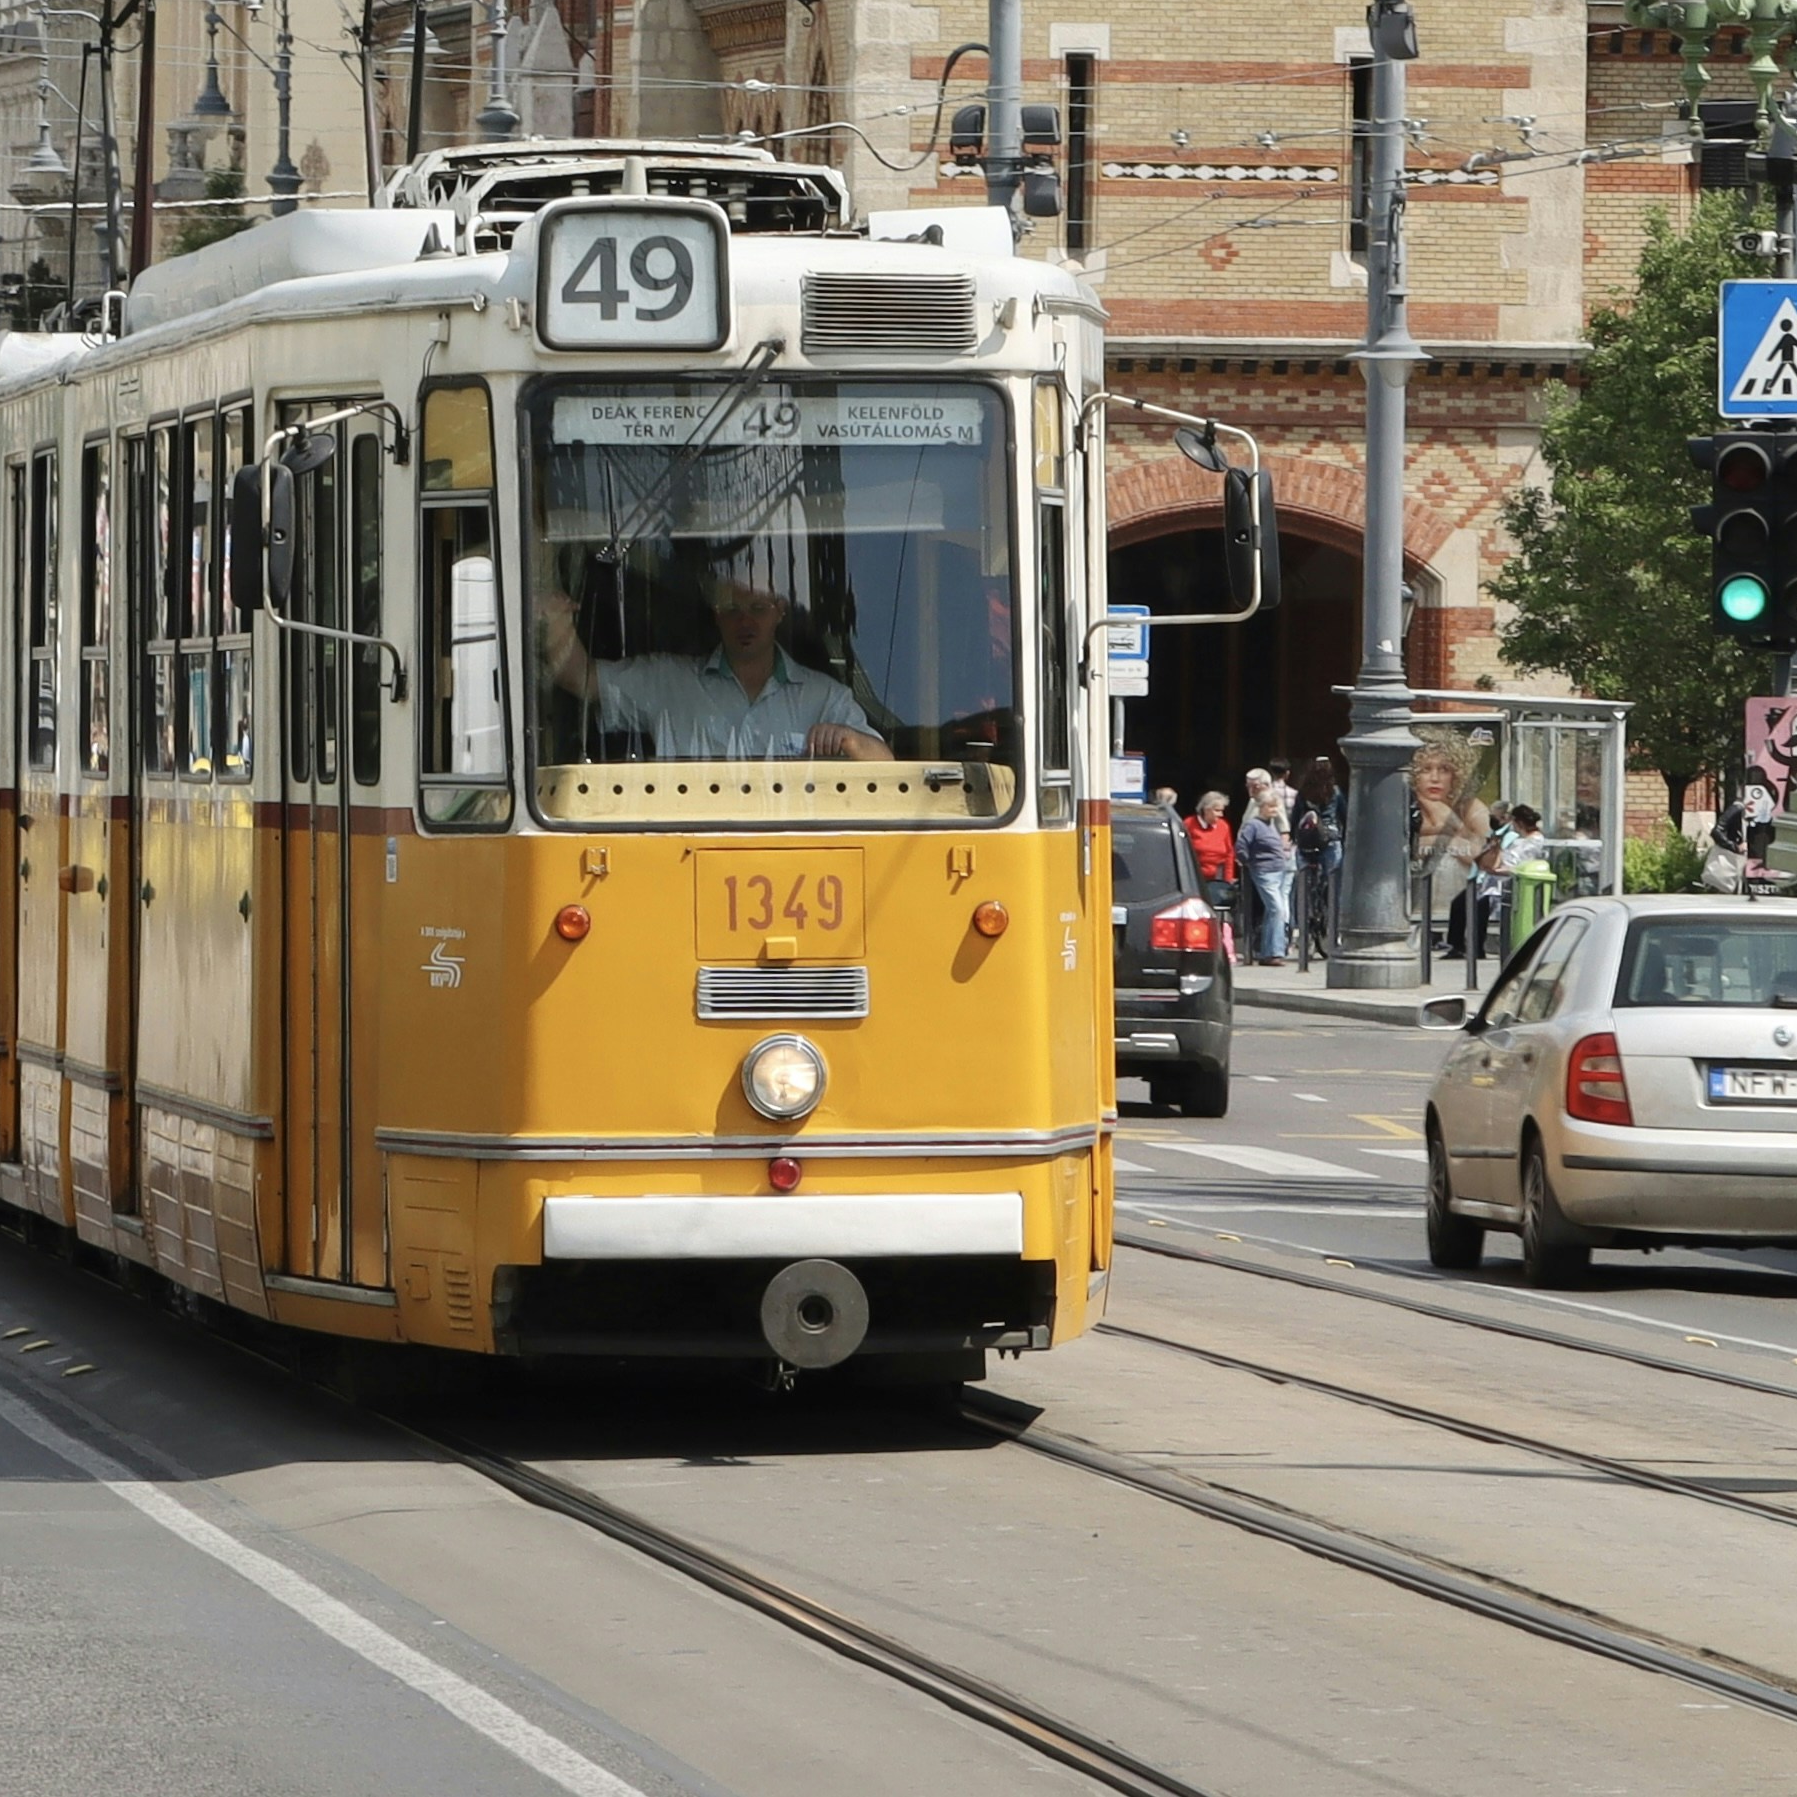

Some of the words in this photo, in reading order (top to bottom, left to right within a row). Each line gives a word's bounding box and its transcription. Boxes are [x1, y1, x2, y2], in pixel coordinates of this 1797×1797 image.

[561, 235, 694, 322] 49
[592, 404, 637, 420] DEÁK
[643, 405, 707, 419] FERENC
[743, 402, 801, 439] 49
[848, 404, 944, 420] KELENFÖLD
[623, 421, 653, 437] TÉR
[659, 424, 675, 437] M
[817, 421, 952, 438] VASÚTÁLLOMÁS
[958, 425, 974, 439] M
[724, 873, 843, 932] 1349
